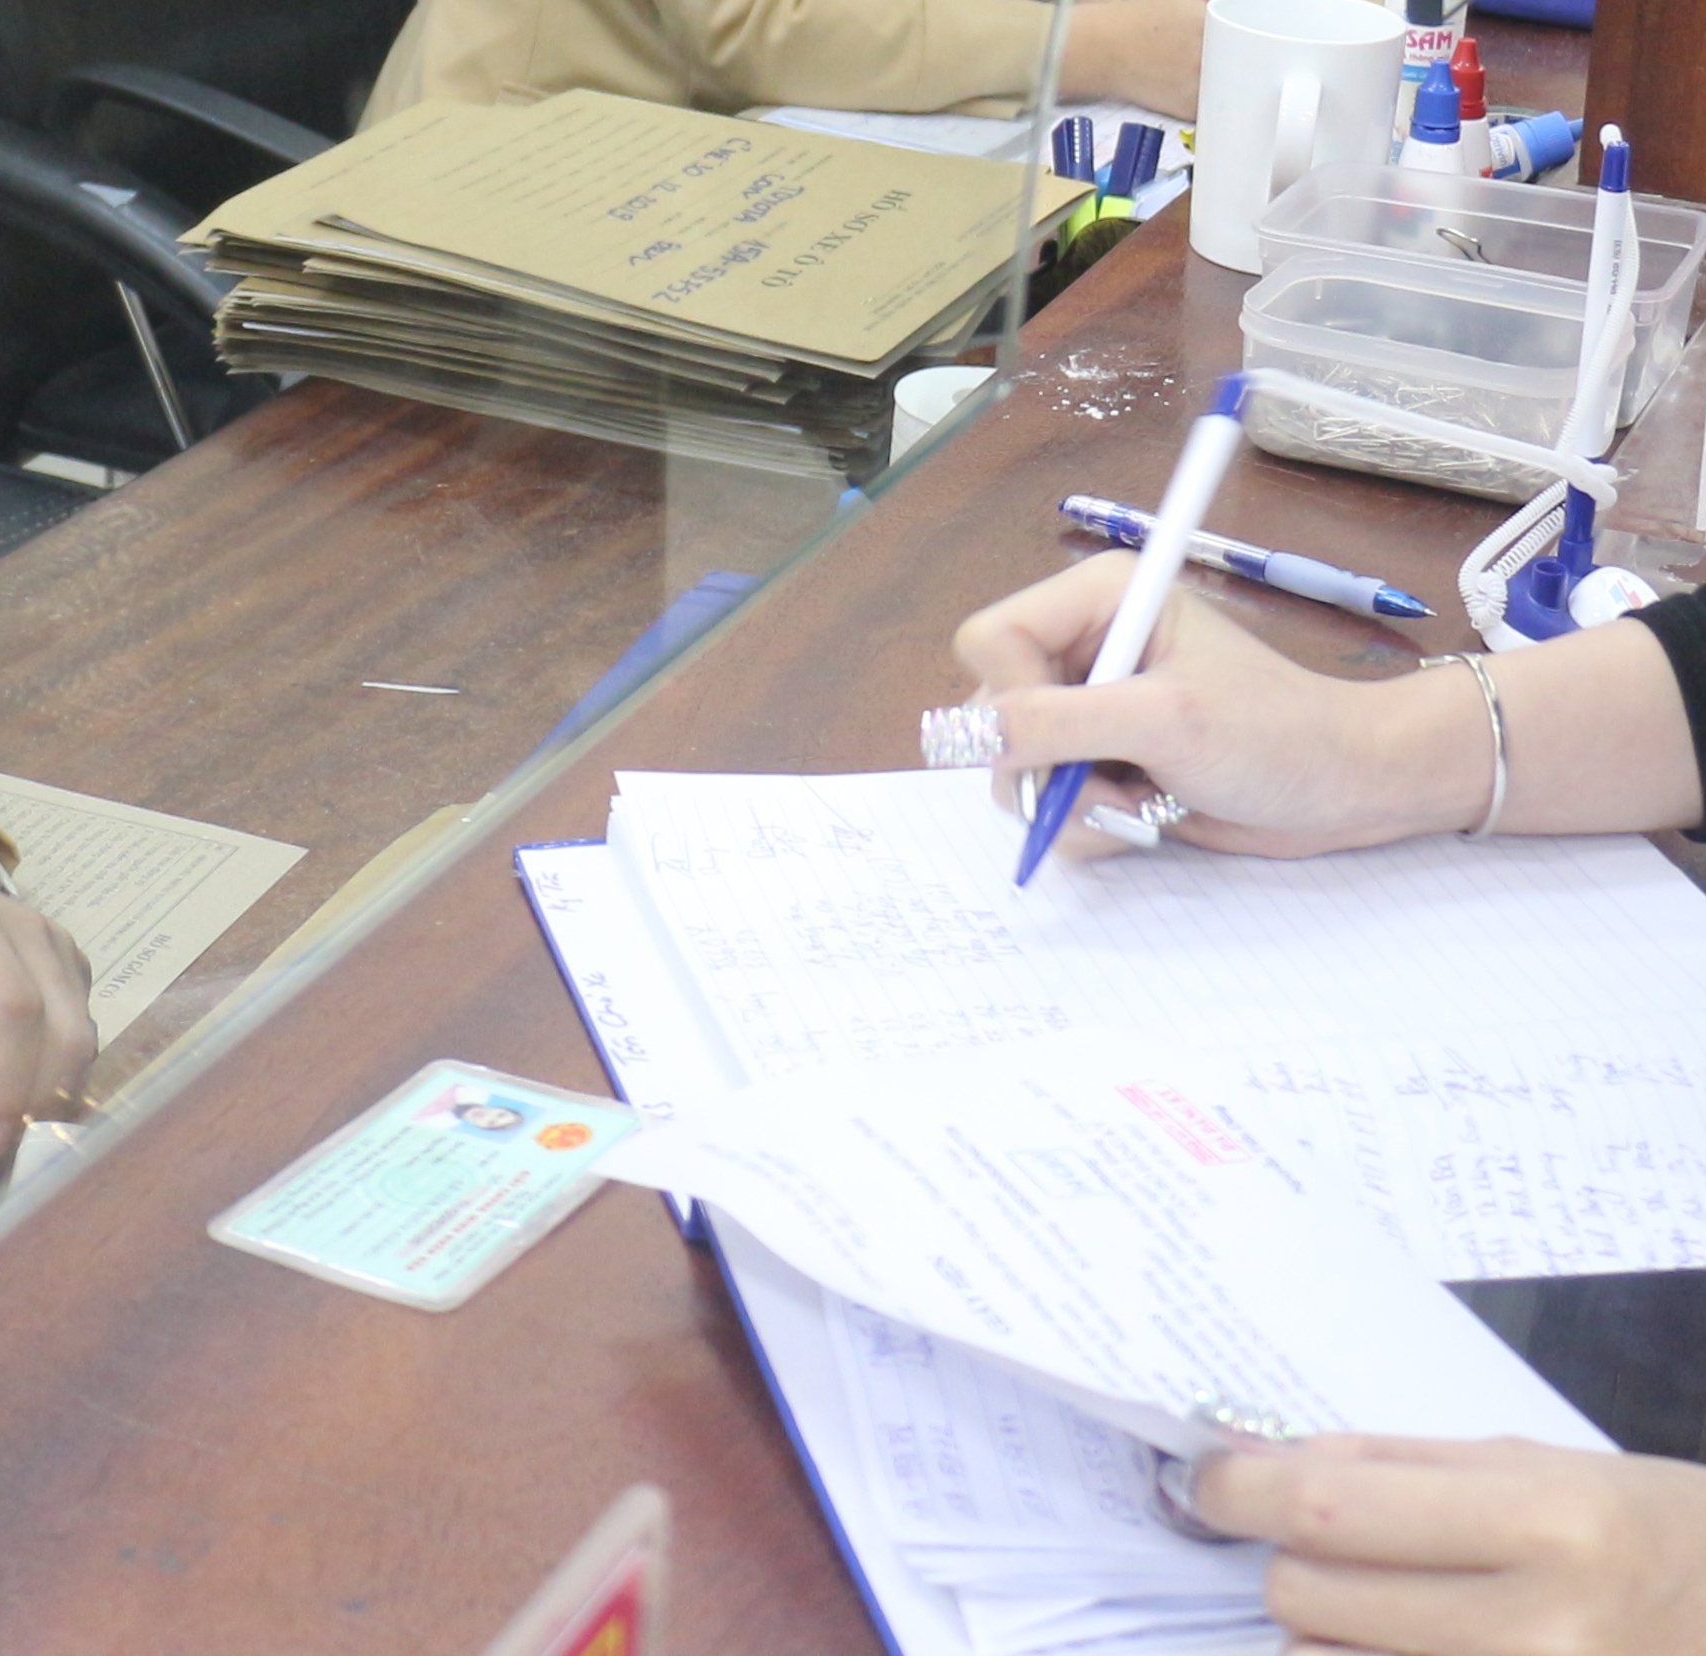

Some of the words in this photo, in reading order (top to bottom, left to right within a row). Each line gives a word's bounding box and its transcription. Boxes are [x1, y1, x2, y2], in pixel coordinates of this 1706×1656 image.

[734, 186, 805, 223] TOYOTA
[843, 212, 879, 233] SƠ
[811, 231, 851, 253] XE
[793, 254, 825, 266] Ô
[761, 269, 802, 288] TÔ
